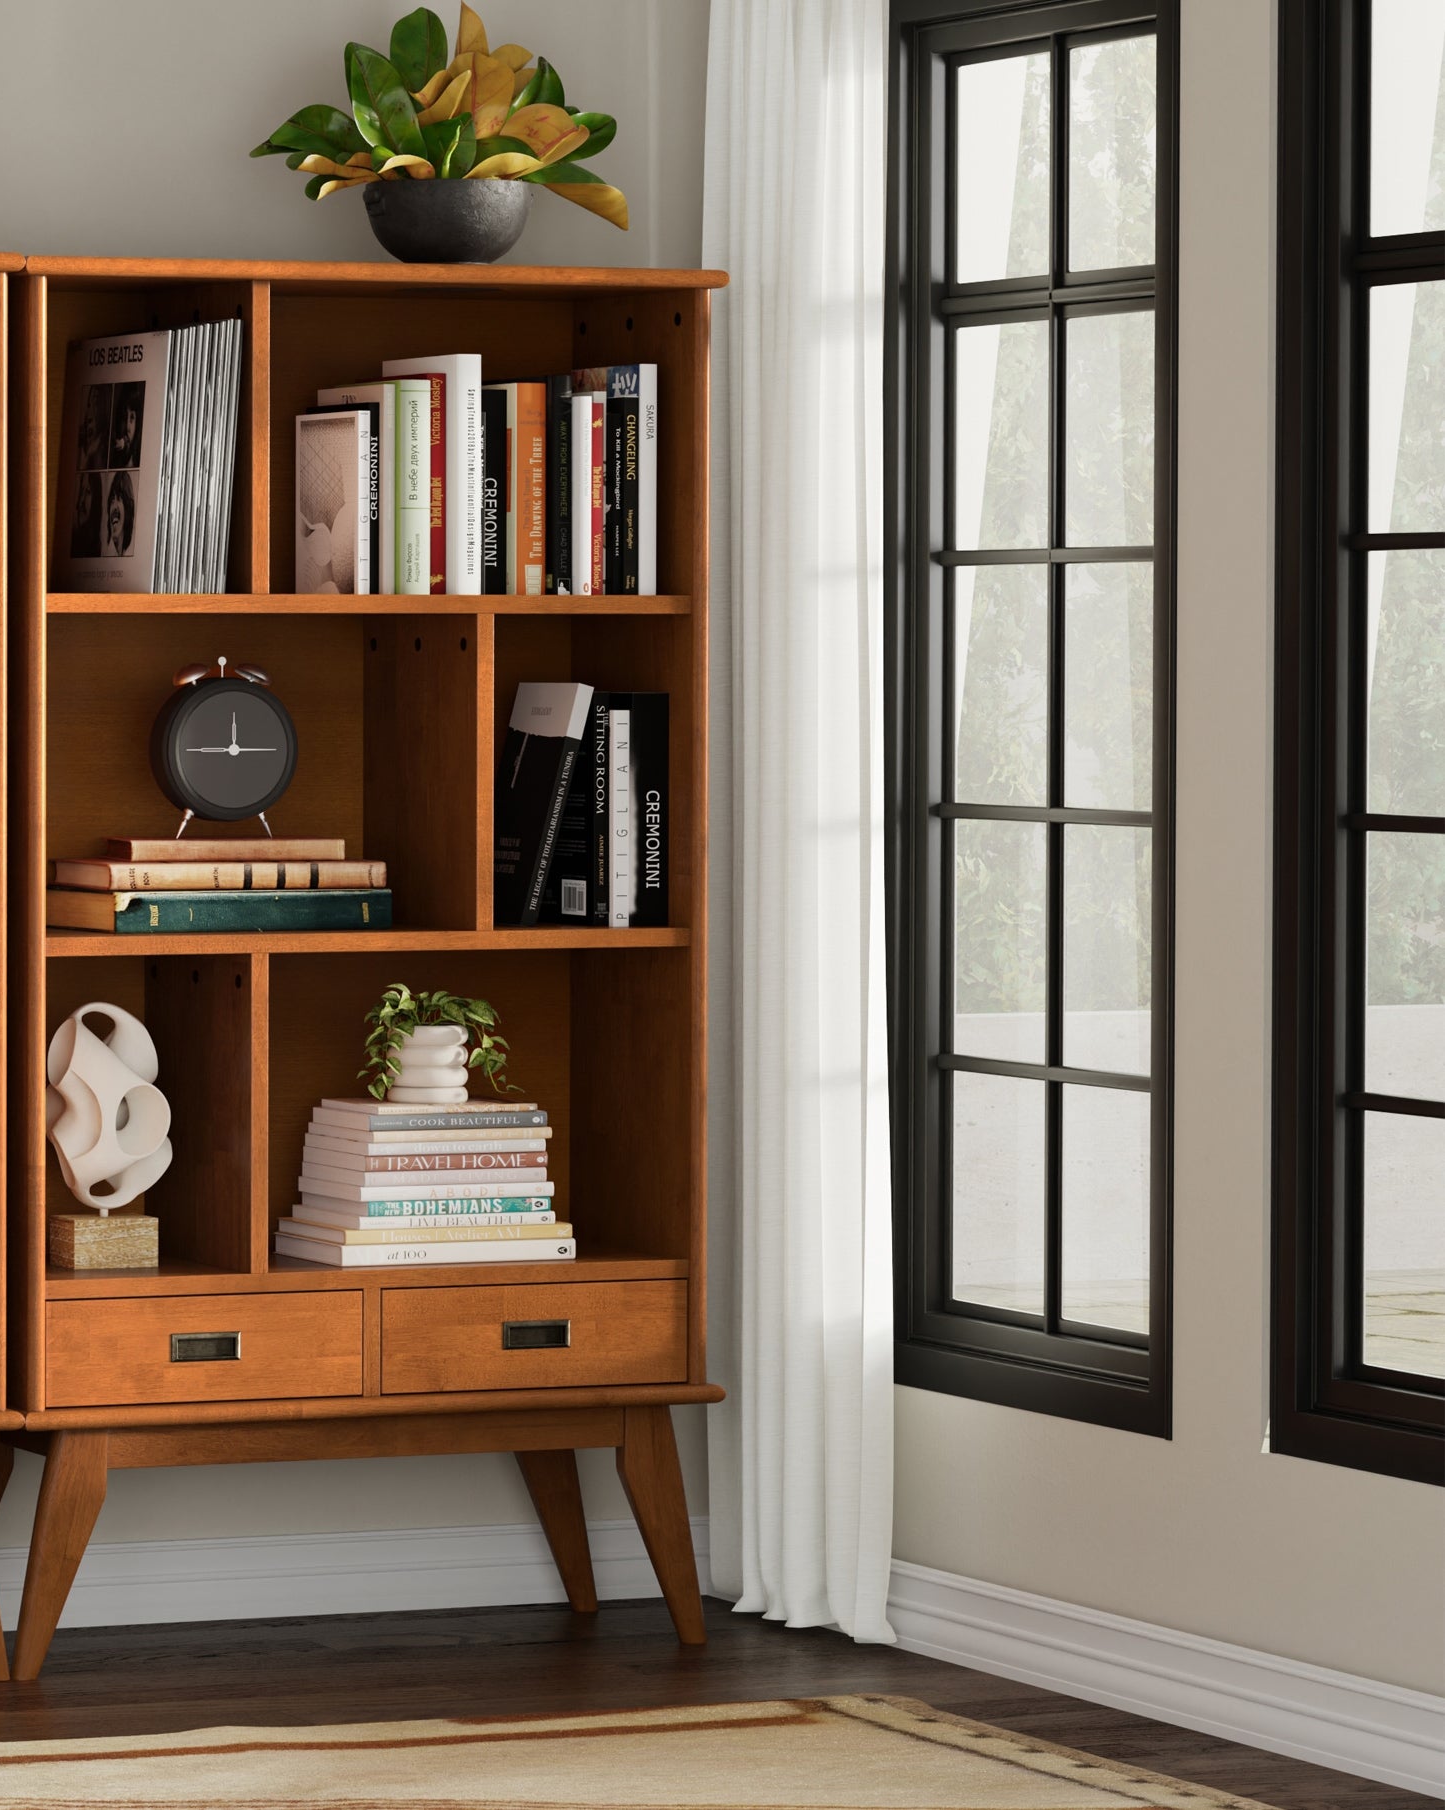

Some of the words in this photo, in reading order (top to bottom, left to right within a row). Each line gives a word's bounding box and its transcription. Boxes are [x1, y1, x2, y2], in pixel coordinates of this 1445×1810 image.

[89, 348, 105, 366] LOS
[107, 345, 143, 364] BEATLES
[430, 377, 443, 408] Mosley
[408, 400, 418, 441] империй
[430, 411, 441, 445] Victoria
[616, 427, 621, 437] To
[646, 405, 654, 440] SAKURA
[411, 444, 419, 466] двух
[529, 437, 542, 464] THREE
[626, 414, 636, 480] CHANGELING
[370, 435, 378, 520] CREMONINI
[532, 468, 542, 483] THE
[532, 486, 542, 496] OF
[484, 478, 497, 567] CREMONINI
[530, 500, 542, 537] DRAWING
[529, 541, 542, 558] THE
[593, 534, 601, 563] Victoria
[591, 564, 601, 590] Mosley
[596, 705, 605, 764] SITTING
[561, 751, 575, 779] TUNDRA
[558, 786, 565, 796] IN
[596, 767, 605, 814] ROOM
[542, 794, 564, 858] TOTALITARIANISM
[616, 722, 628, 920] PITIGLIANI
[645, 790, 660, 889] CREMONINI
[540, 859, 548, 869] OF
[532, 869, 546, 895] LEGACY
[528, 894, 539, 912] THE
[409, 1116, 446, 1127] COOK
[451, 1116, 520, 1126] BEAUTIFUL
[386, 1154, 455, 1170] TRAVEL
[461, 1153, 527, 1168] HOME
[403, 1198, 503, 1215] BOHEMIANS
